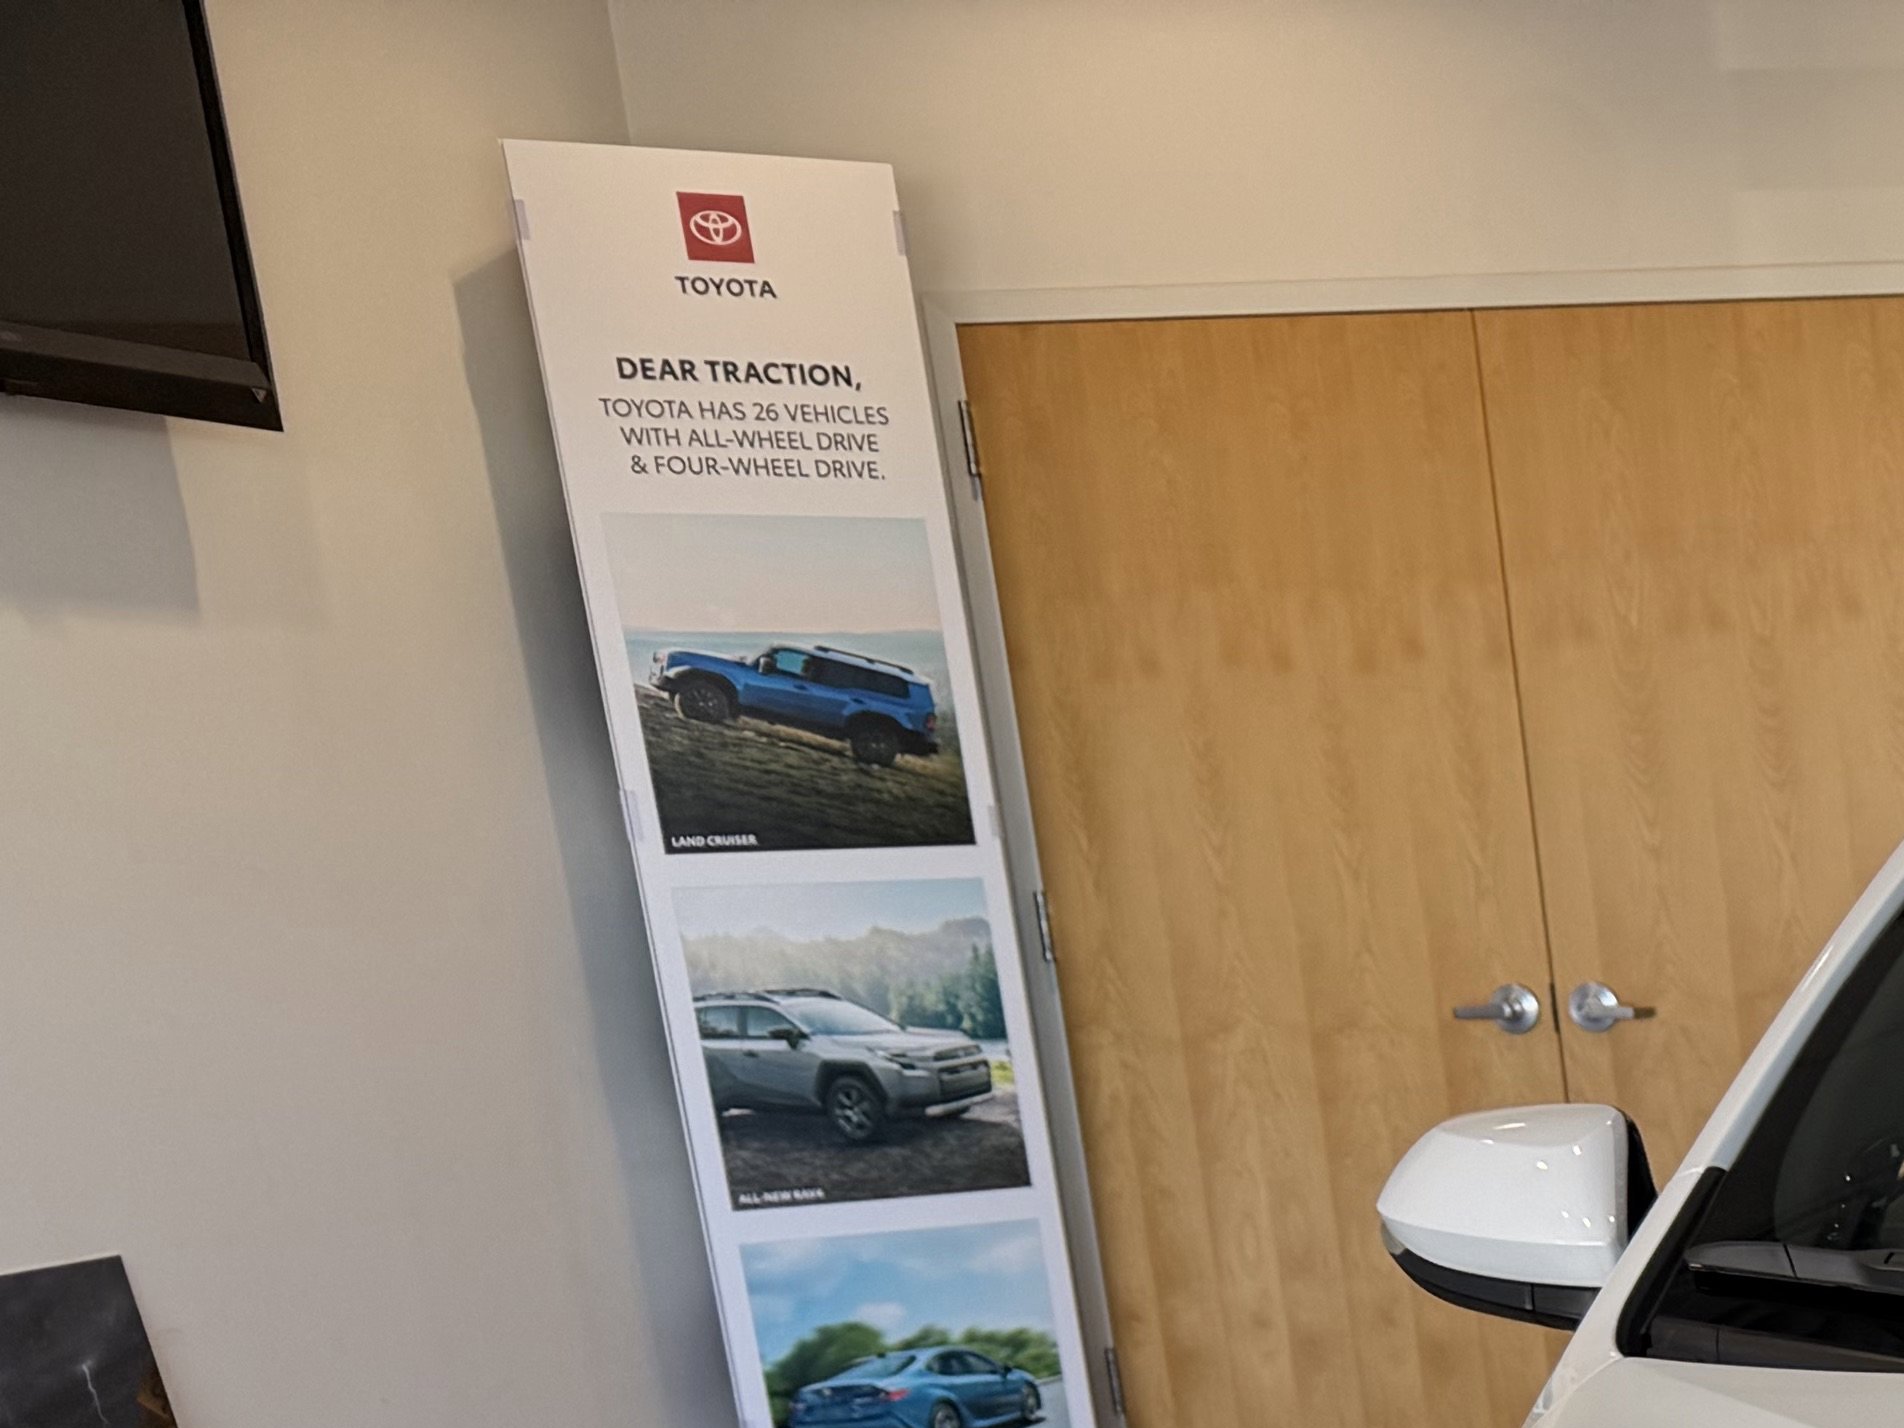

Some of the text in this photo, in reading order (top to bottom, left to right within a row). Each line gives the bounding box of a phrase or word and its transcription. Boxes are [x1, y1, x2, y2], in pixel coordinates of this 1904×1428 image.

[675, 276, 777, 299] TOYOTA
[616, 357, 861, 391] DEAR TRACTION,
[598, 398, 889, 426] TOYOTA HAS 26 VEHICLES
[619, 426, 879, 452] WITH ALL-WHEEL DRIVE
[630, 455, 885, 480] & FOUR-WHEEL DRIVE.
[671, 834, 759, 848] LAND CRUISER
